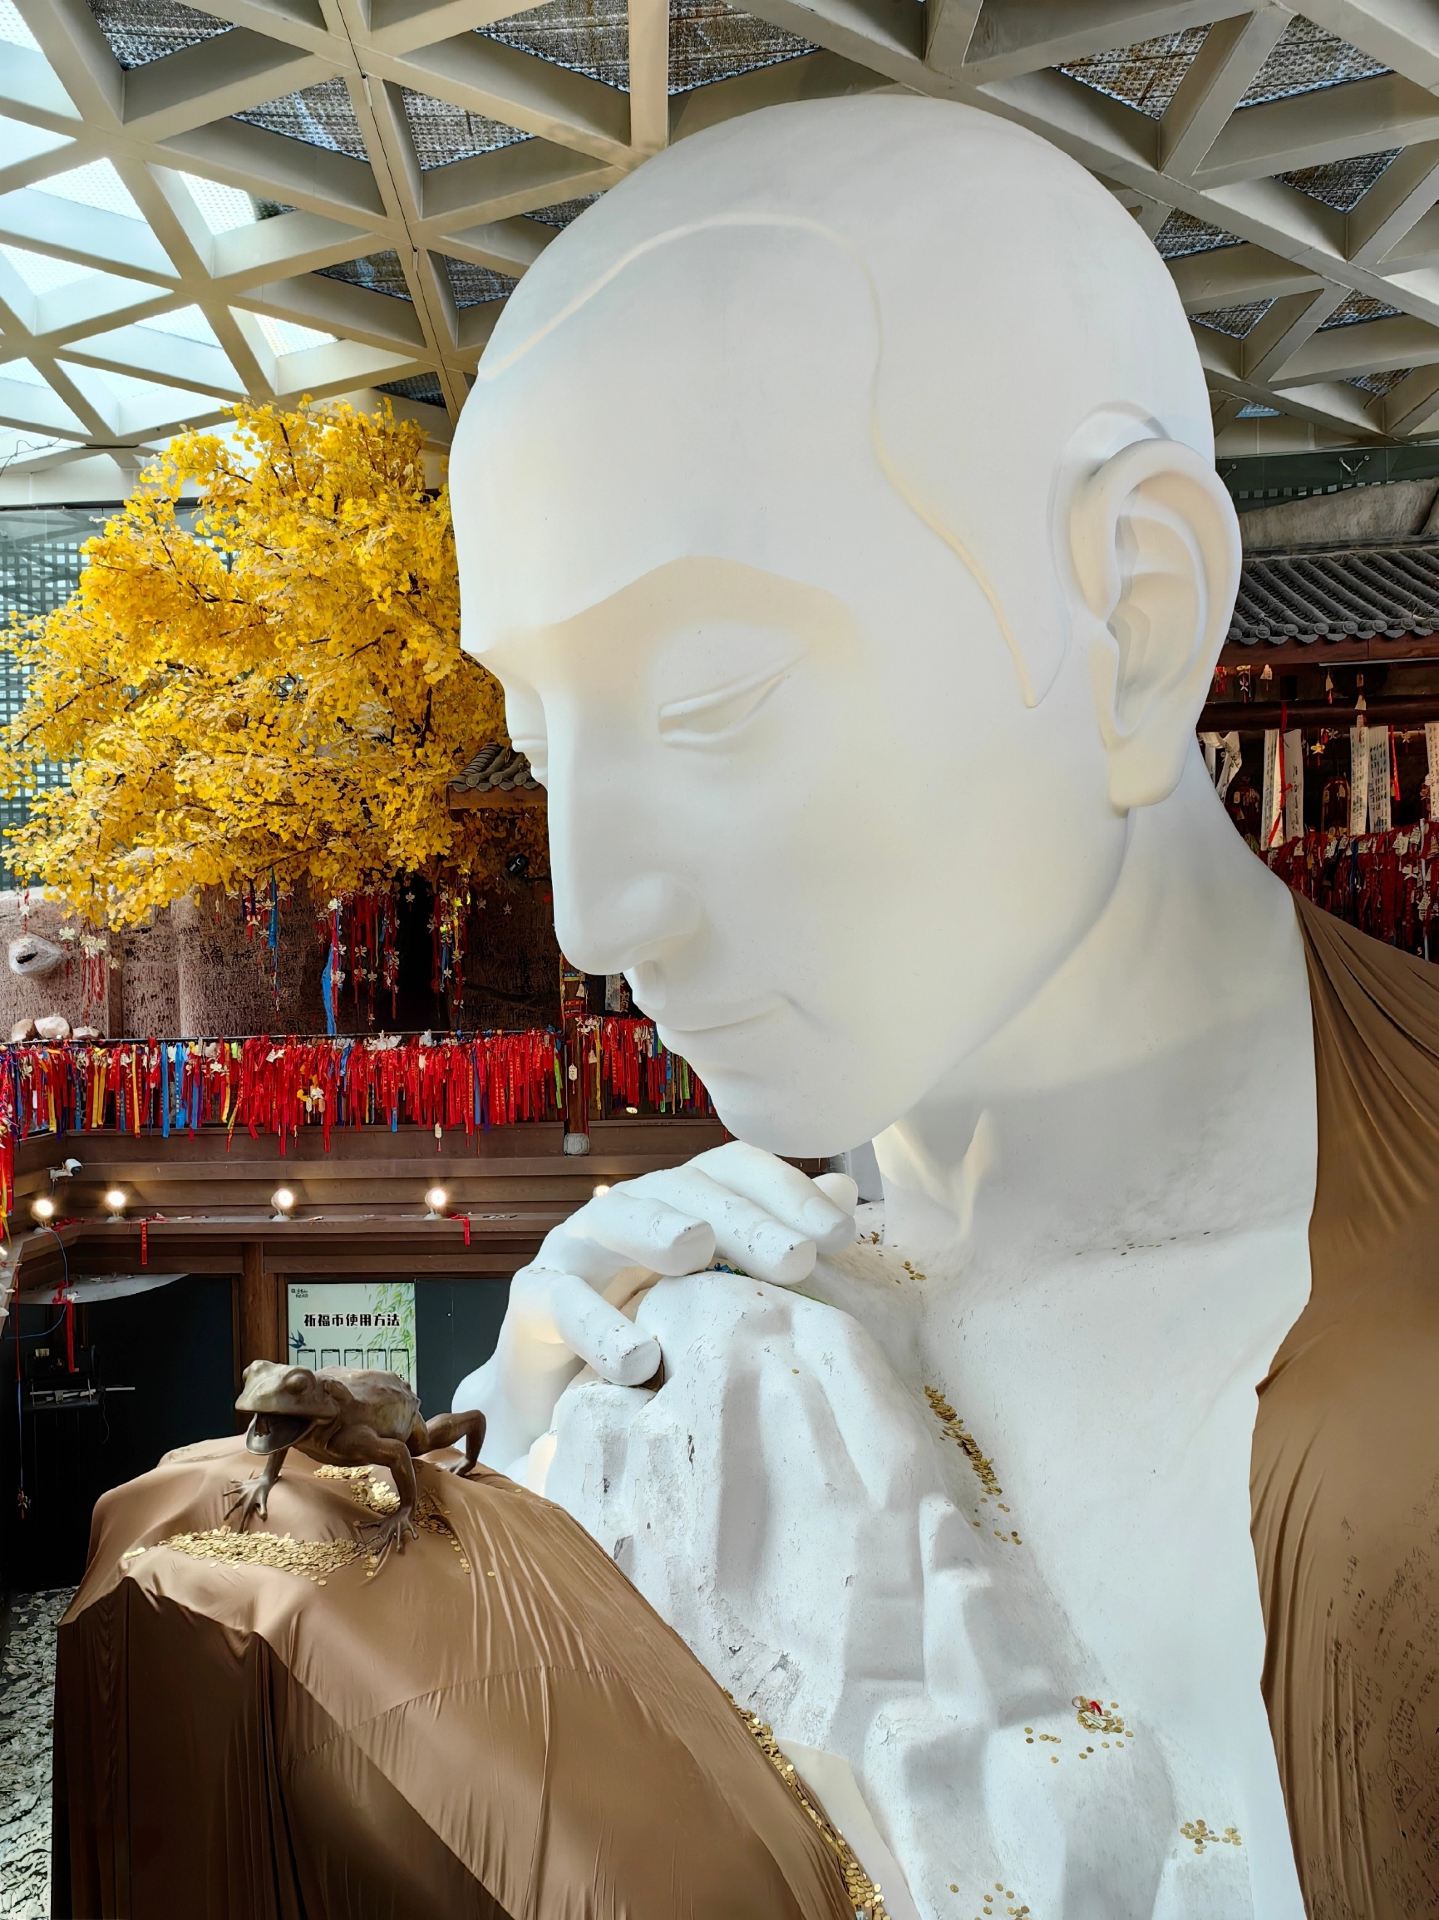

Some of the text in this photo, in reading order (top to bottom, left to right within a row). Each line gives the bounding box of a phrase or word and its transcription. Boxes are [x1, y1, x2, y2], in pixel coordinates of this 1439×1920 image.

[304, 1313, 400, 1327] 祈福币使用方法
